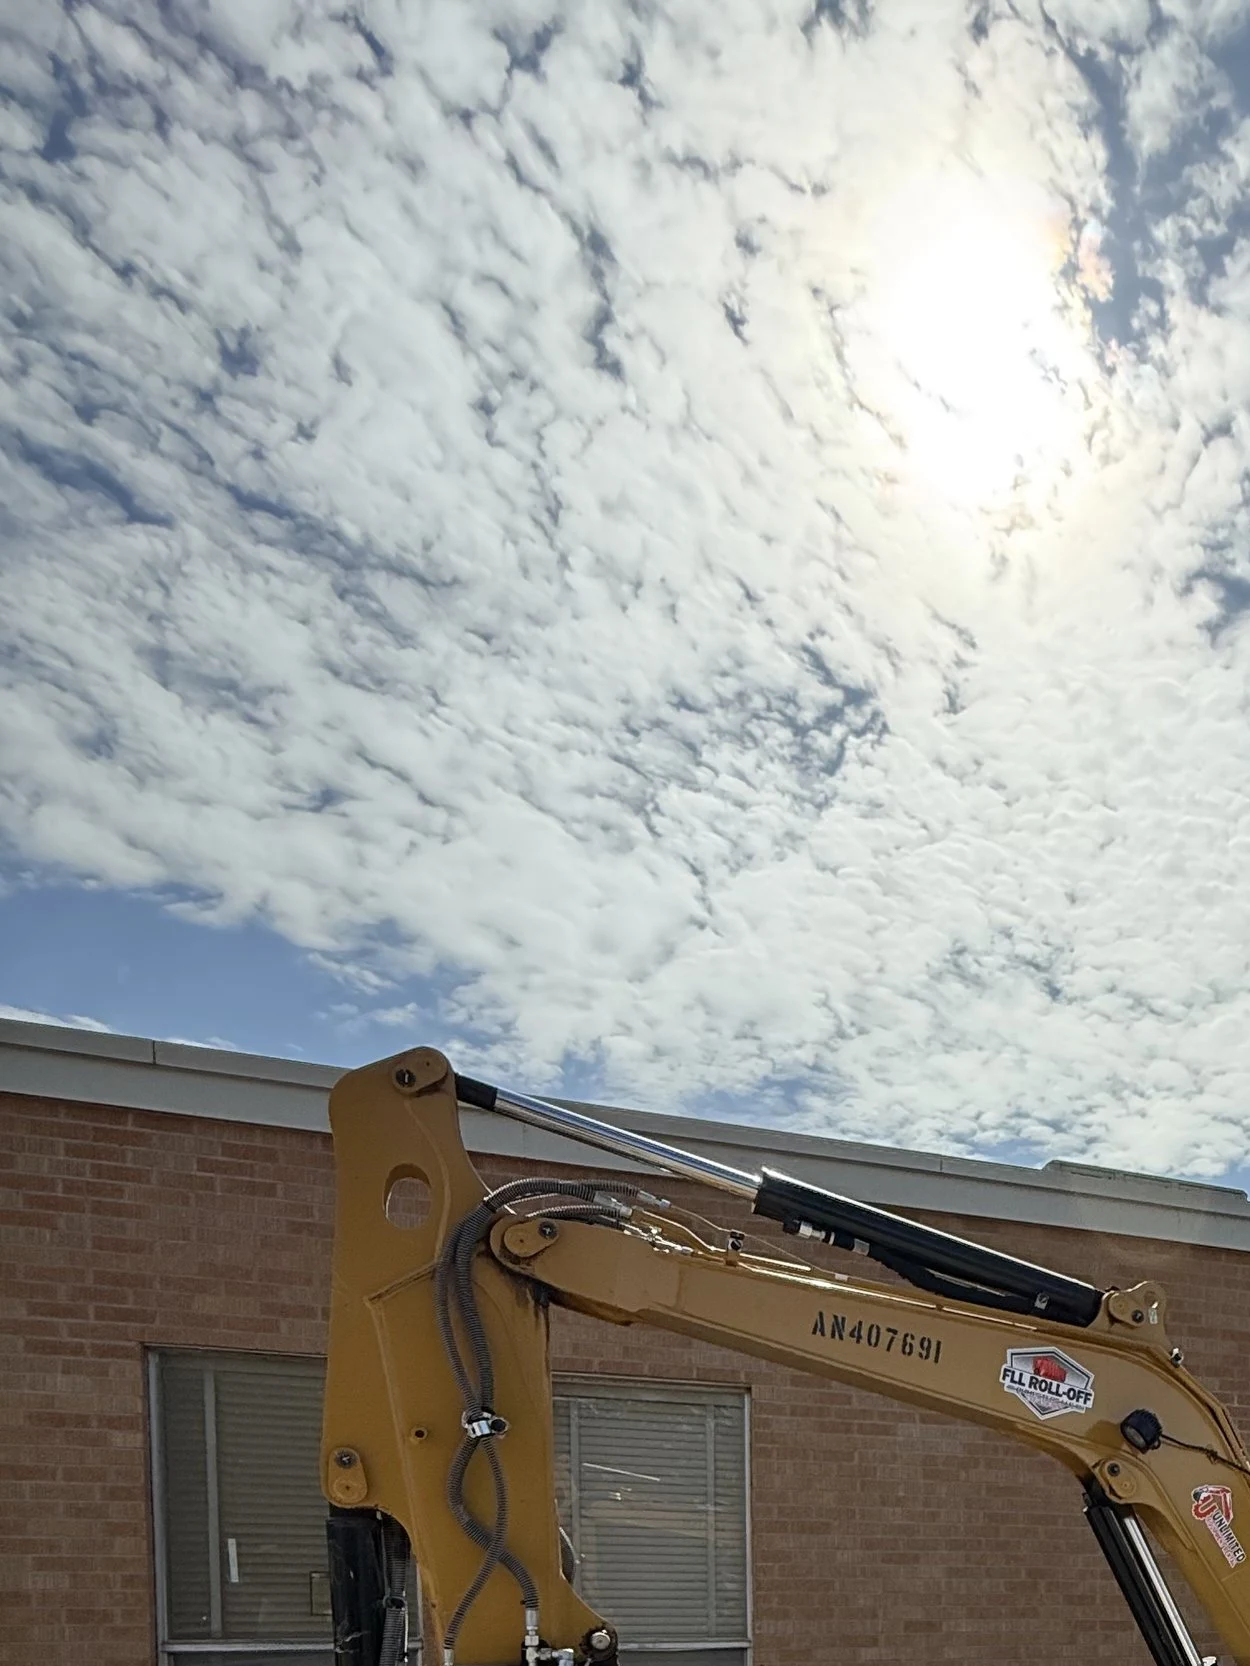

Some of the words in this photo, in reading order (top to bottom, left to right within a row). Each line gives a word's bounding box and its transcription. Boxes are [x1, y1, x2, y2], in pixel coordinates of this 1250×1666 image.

[811, 1311, 942, 1364] AN407691
[1002, 1368, 1026, 1387] FLL
[1028, 1376, 1092, 1405] ROLL-OFF
[1212, 1511, 1245, 1562] UNLIMITED
